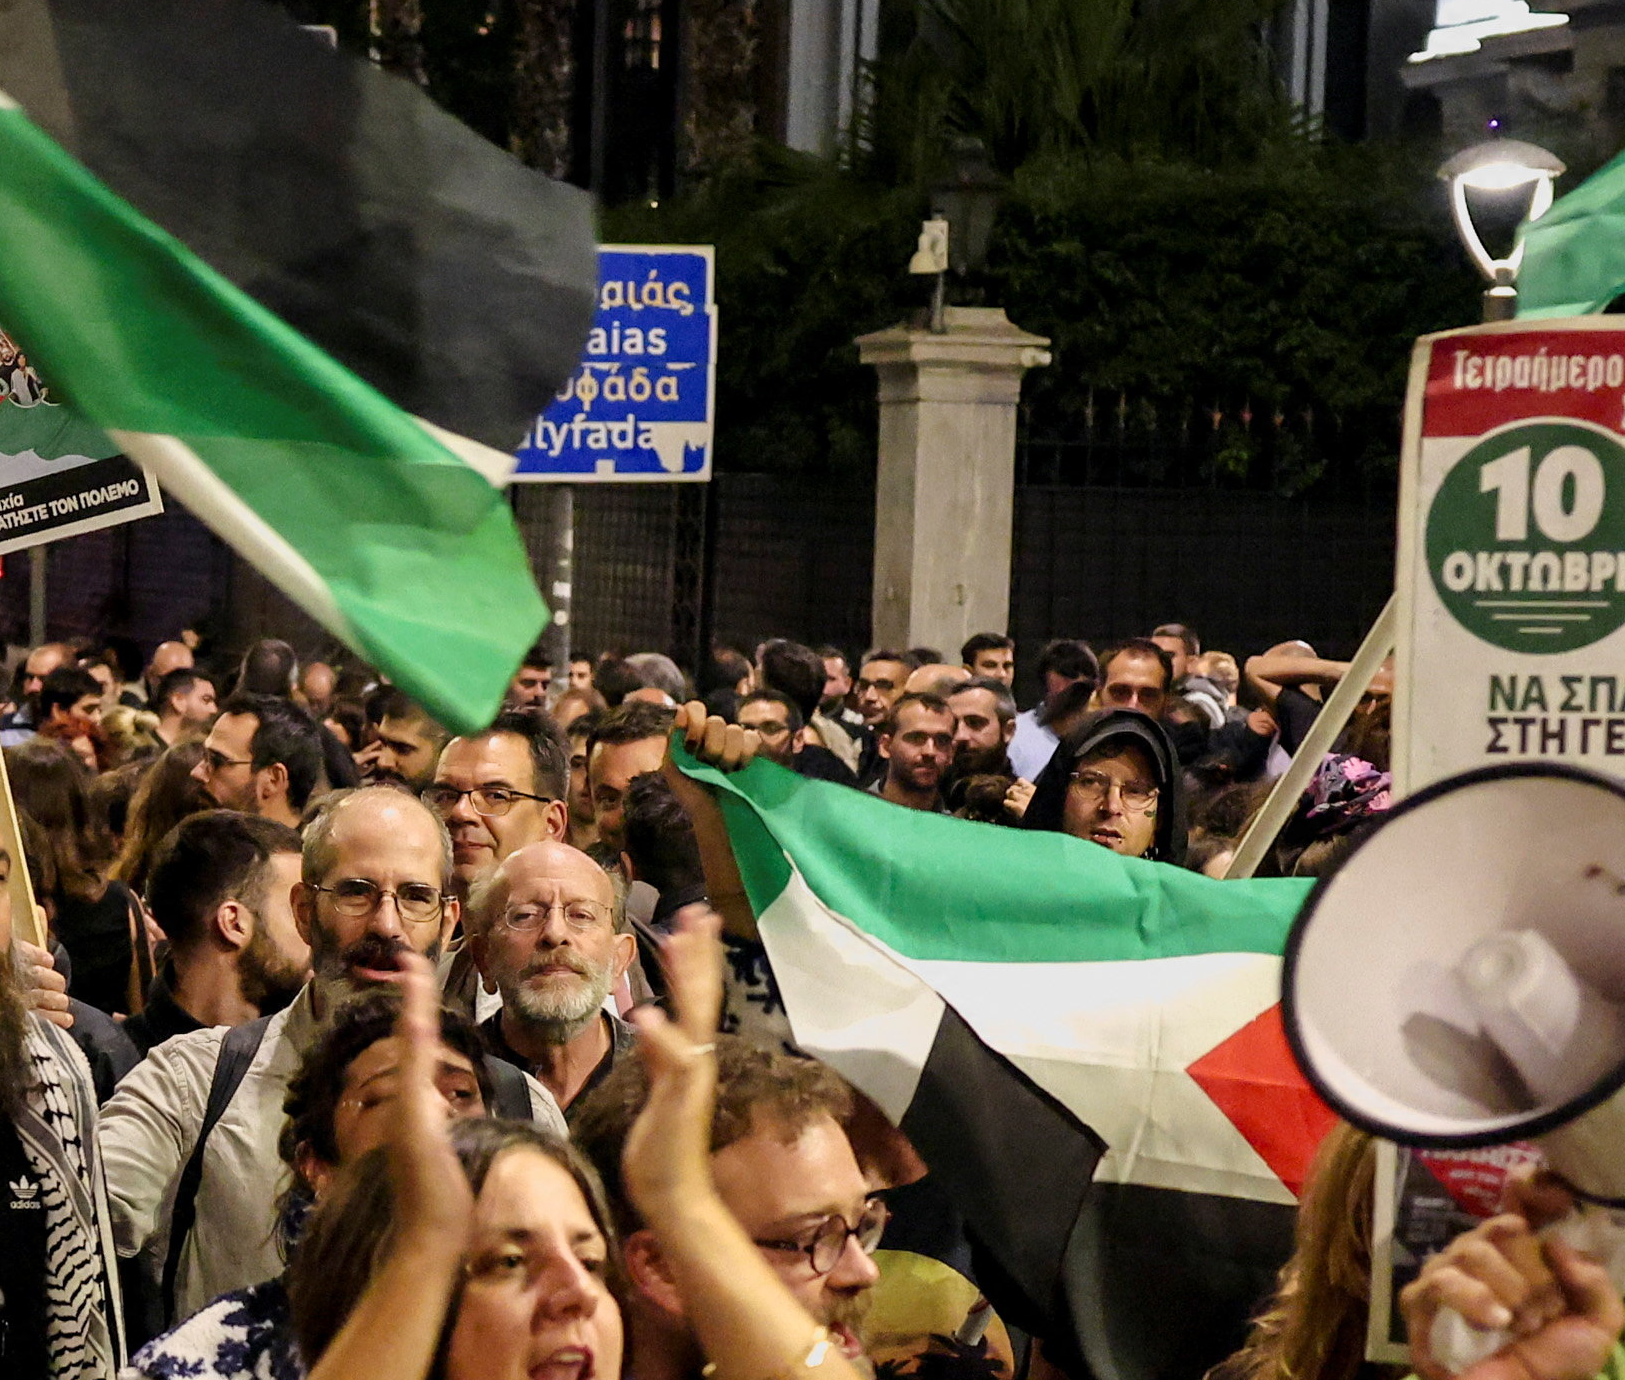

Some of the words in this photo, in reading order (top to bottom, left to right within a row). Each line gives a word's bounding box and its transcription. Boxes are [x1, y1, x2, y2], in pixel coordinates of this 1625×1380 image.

[600, 269, 695, 316] αιάς
[586, 320, 668, 356] aias
[1453, 347, 1625, 393] Τετραήμερο
[49, 495, 80, 517] ΤΟΝ
[80, 478, 140, 508] ΠΟΛΕΜΟ
[1478, 444, 1606, 543] 10
[1488, 674, 1549, 713] ΝΑ
[1485, 716, 1567, 756] ΣΤΗ
